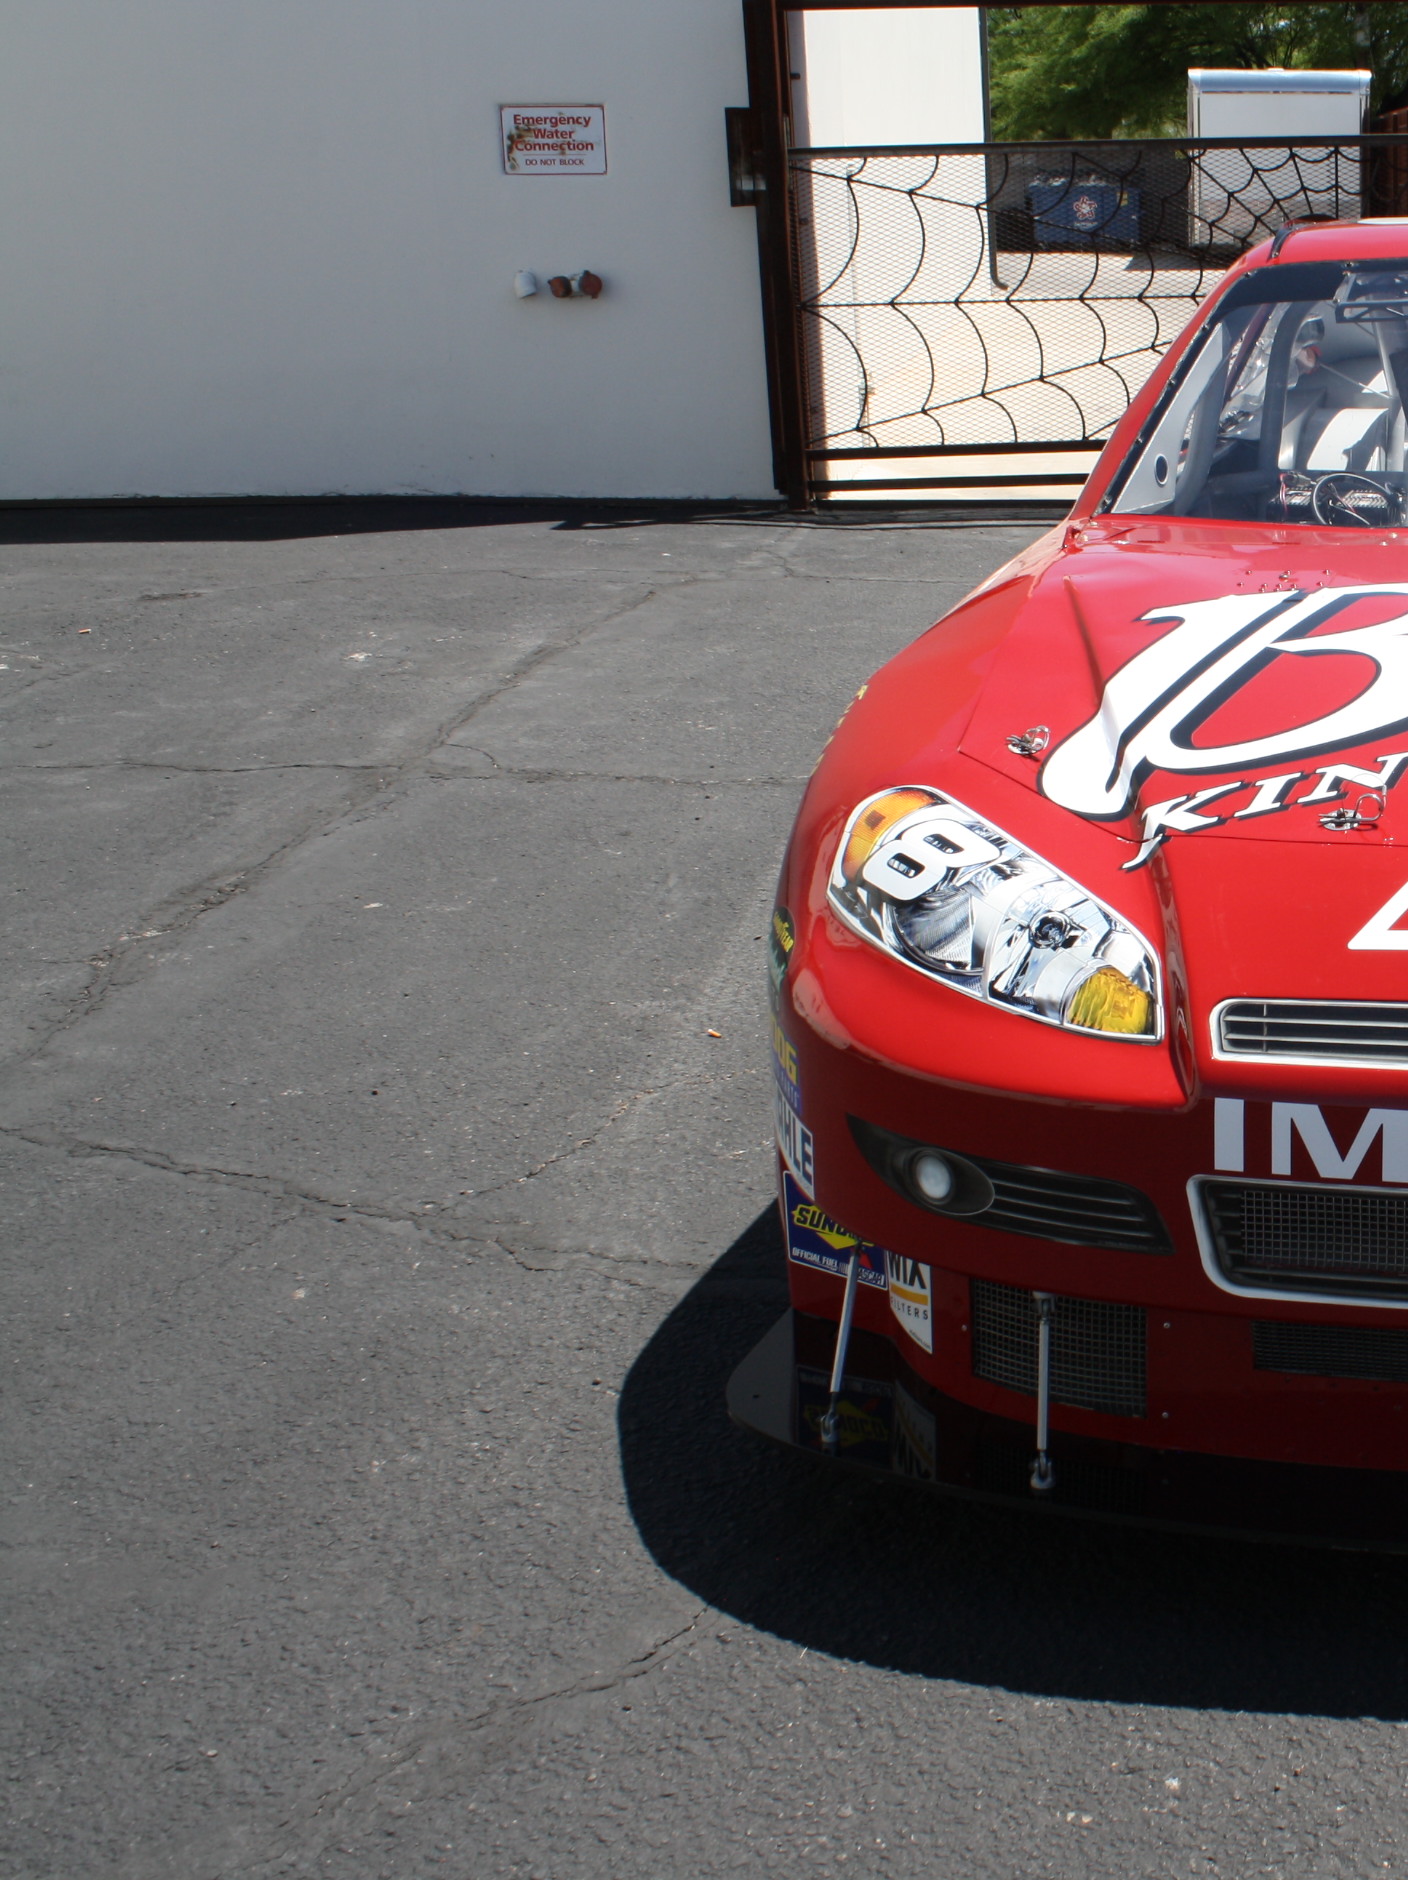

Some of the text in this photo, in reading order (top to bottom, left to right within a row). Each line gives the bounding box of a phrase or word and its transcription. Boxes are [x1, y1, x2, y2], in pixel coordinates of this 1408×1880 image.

[513, 114, 591, 128] Emergency
[533, 128, 575, 140] Water
[514, 140, 594, 152] Connection
[525, 158, 585, 166] DO NOT BLOCK
[862, 818, 1001, 901] 8
[821, 1255, 838, 1268] FUEL
